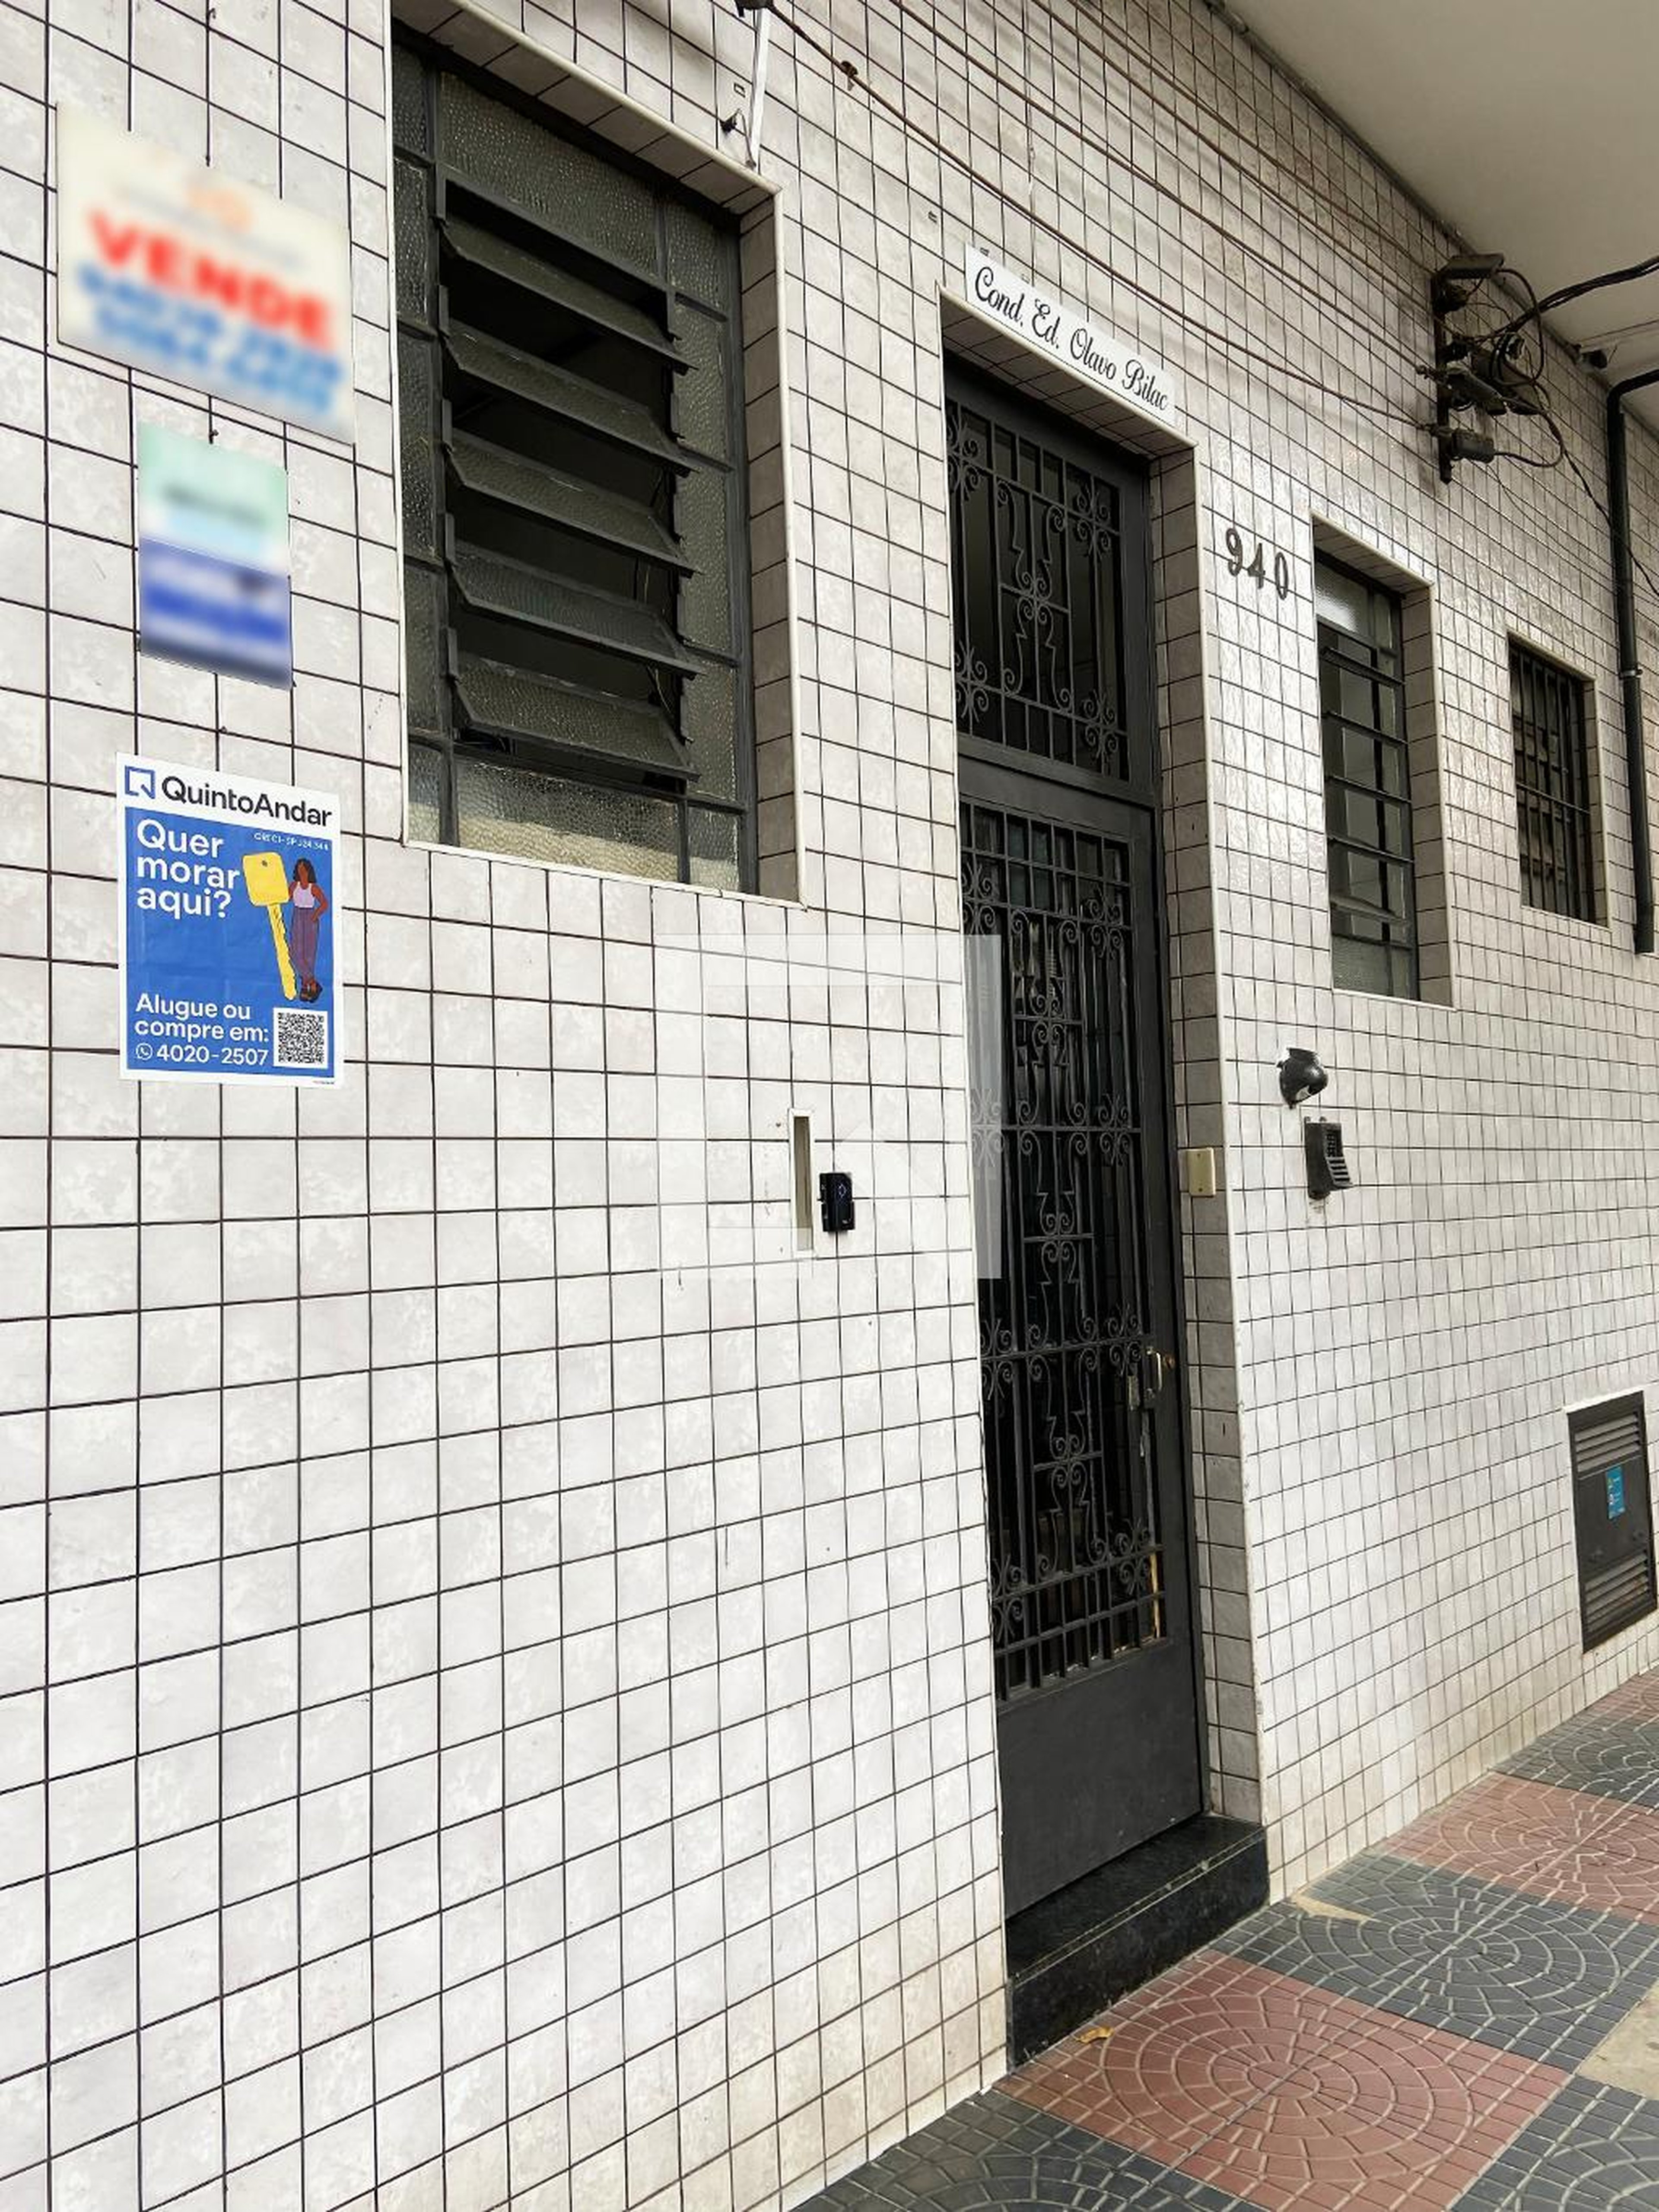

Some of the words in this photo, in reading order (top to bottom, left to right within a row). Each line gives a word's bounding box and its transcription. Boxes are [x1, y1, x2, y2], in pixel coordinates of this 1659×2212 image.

[975, 266, 1024, 327] Cond.
[1032, 297, 1060, 349] Ed.
[1070, 328, 1117, 380] Olavo
[1122, 359, 1168, 410] Bilac
[1226, 528, 1289, 600] 940
[162, 775, 333, 827] QuintoAndar
[137, 819, 224, 858] Quer
[137, 856, 240, 889] morar
[137, 887, 231, 920] aqui?
[136, 993, 218, 1020] Alugue
[223, 1004, 251, 1019] ou
[135, 1020, 224, 1042] compre
[229, 1026, 269, 1042] em:
[157, 1044, 268, 1066] 4020-2507
